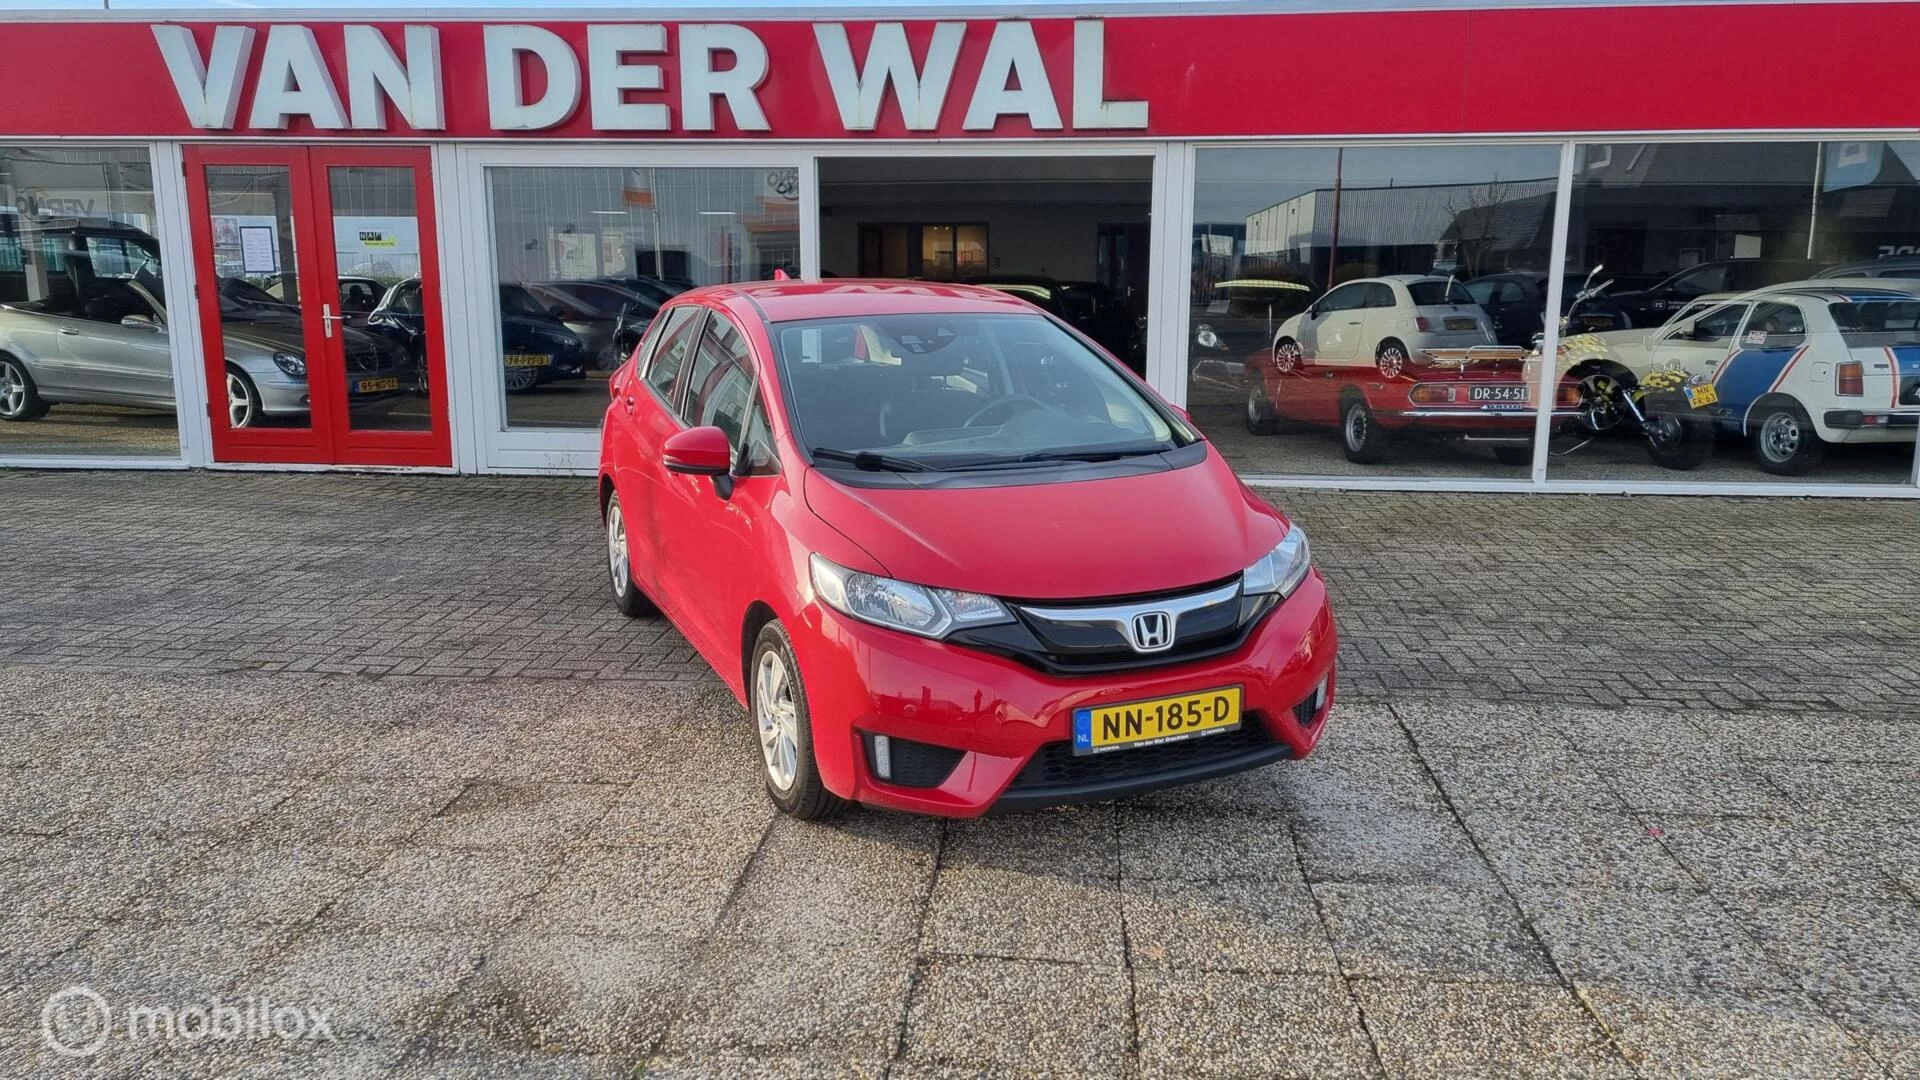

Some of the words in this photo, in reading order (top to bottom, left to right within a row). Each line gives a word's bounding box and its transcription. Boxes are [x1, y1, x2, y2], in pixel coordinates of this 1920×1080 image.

[151, 24, 446, 130] VAN
[483, 23, 772, 131] DER
[812, 20, 1149, 130] WAL
[1474, 387, 1525, 400] DR-54-51
[1103, 696, 1230, 740] NN-185-D
[1077, 733, 1089, 743] NL
